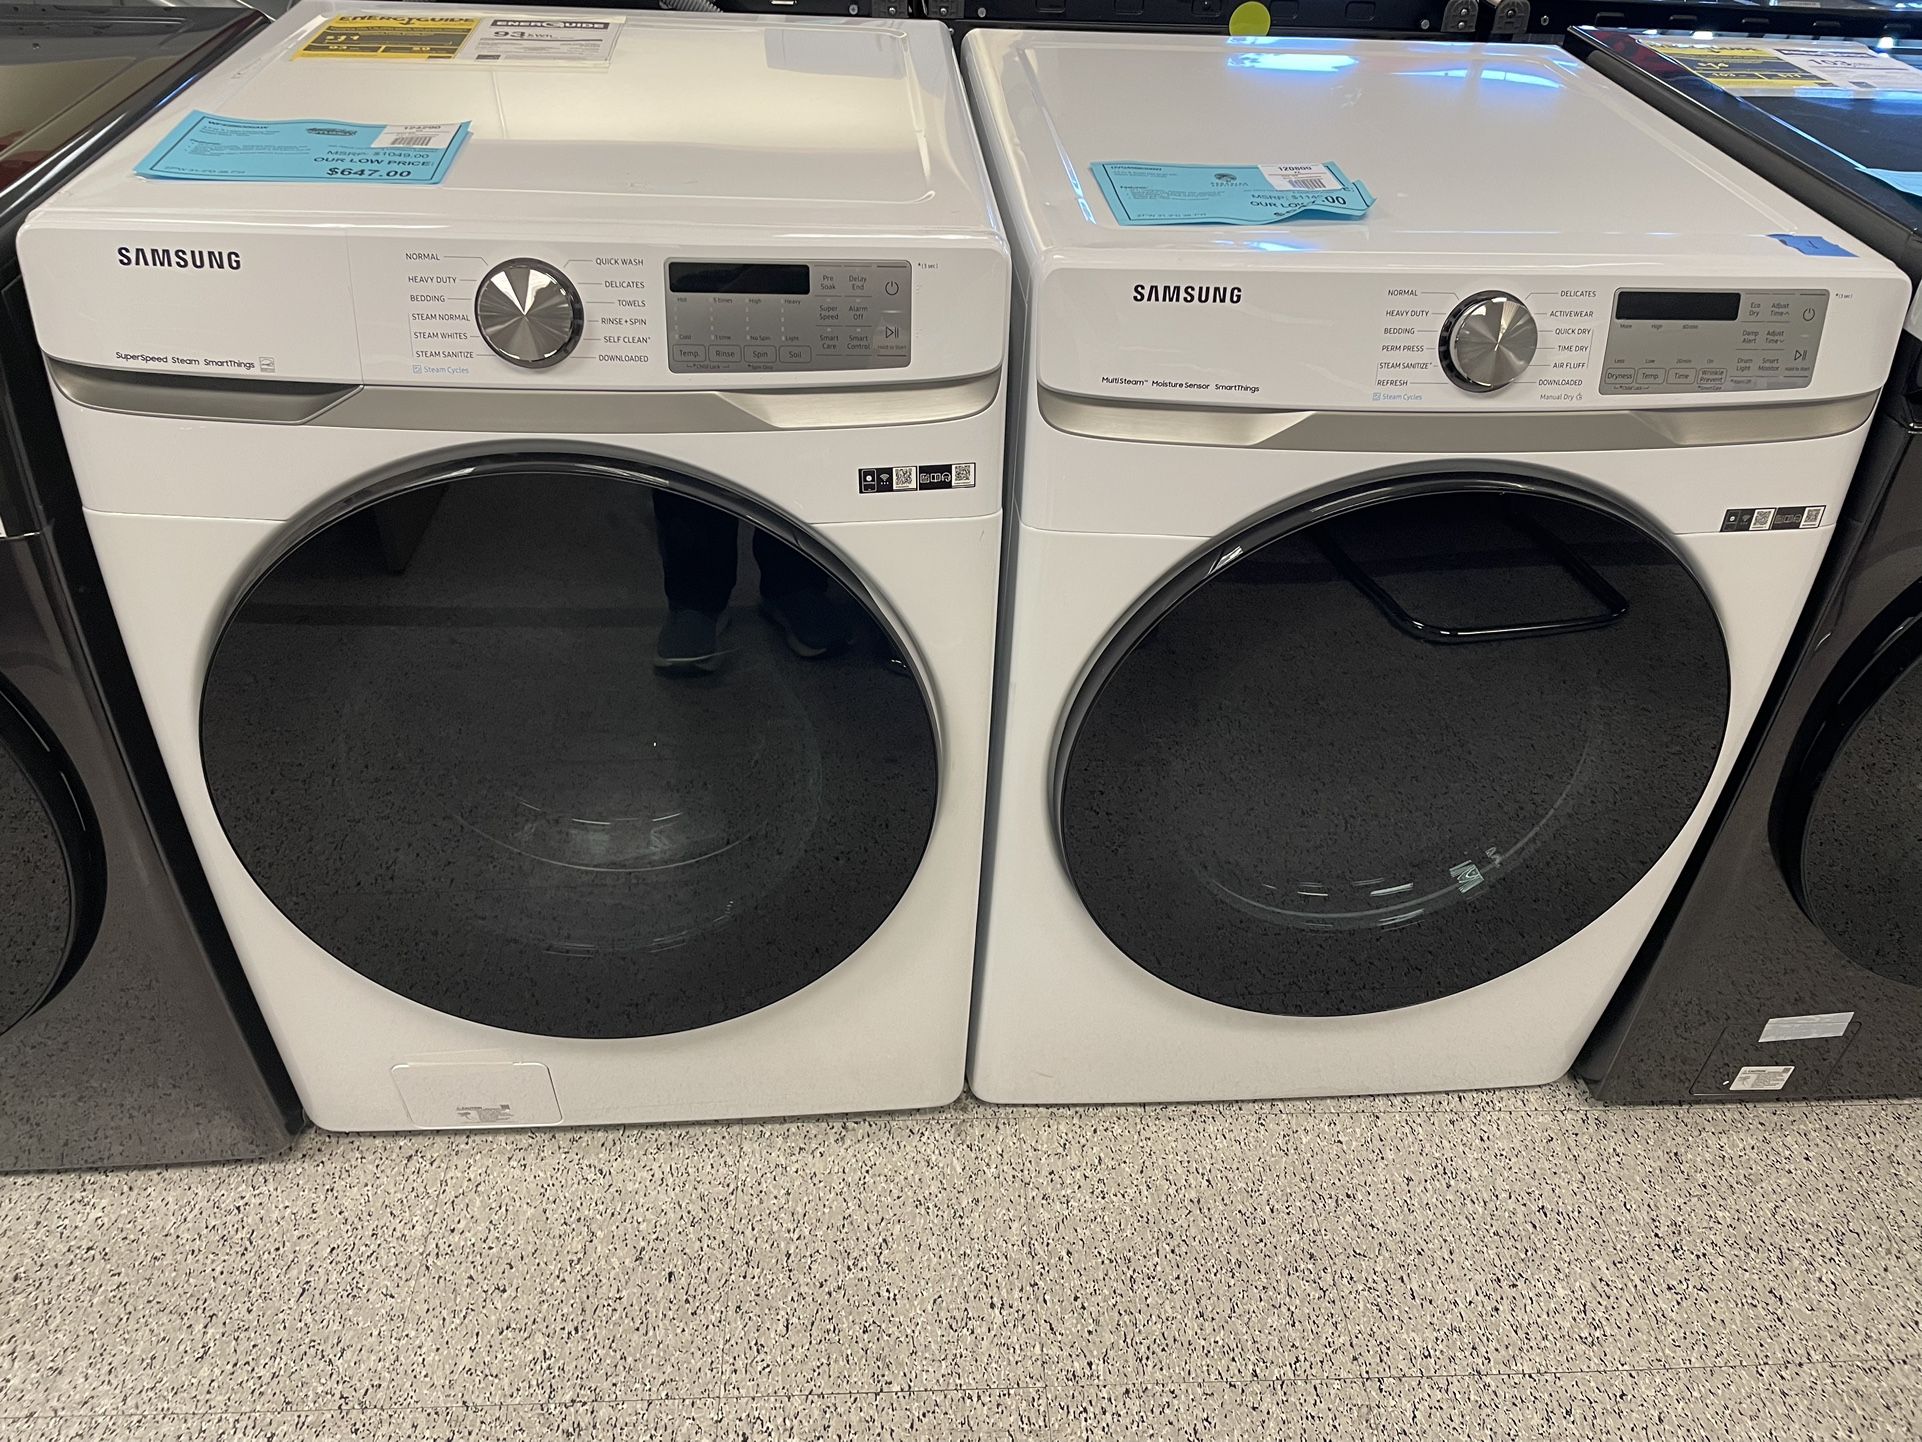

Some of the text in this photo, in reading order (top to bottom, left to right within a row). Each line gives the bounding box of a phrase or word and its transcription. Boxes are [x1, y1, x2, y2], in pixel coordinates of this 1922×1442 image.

[349, 157, 384, 165] LOW
[325, 166, 412, 178] $647.00
[117, 246, 241, 271] SAMSUNG
[405, 253, 441, 261] NORMAL
[595, 257, 645, 266] QUICK WASH
[408, 275, 457, 284] HEAVY DUTY
[848, 275, 867, 284] Delay
[604, 280, 646, 289] DELICATES
[851, 283, 865, 291] End
[1133, 284, 1242, 304] SAMSUNG
[1387, 289, 1418, 297] NORMAL
[1560, 290, 1597, 298] DELICATES
[410, 294, 446, 303] BEDDING
[617, 299, 647, 308] TOWELS
[1771, 302, 1790, 310] Adjust
[819, 305, 838, 313] Super
[1385, 309, 1410, 317] HEAVY
[412, 313, 471, 322] STEAM NORMAL
[819, 313, 839, 321] Speed
[1549, 310, 1594, 318] ACTIVEWEAR
[1749, 310, 1759, 318] Dry
[1383, 327, 1415, 335] BEDDING
[1742, 330, 1759, 338] Damp
[413, 331, 468, 340] STEAM WHITES
[603, 335, 621, 344] SELF
[1402, 345, 1424, 353] PRESS
[415, 350, 475, 359] STEAM SANITIZE
[716, 350, 735, 358] Rinse
[752, 350, 768, 360] Spin
[788, 351, 802, 359] Soil
[116, 351, 255, 371] SuperSpeed Steam SmartThings
[598, 354, 649, 363] DOWNLOADED
[423, 366, 446, 374] Steam
[1607, 372, 1633, 381] Dryness
[1151, 380, 1183, 389] Moisture
[1184, 381, 1210, 390] Sensor
[1214, 384, 1260, 393] SmartThings
[1538, 379, 1583, 387] DOWNLOADED
[1382, 392, 1402, 400] Steam
[1563, 393, 1574, 402] Dry
